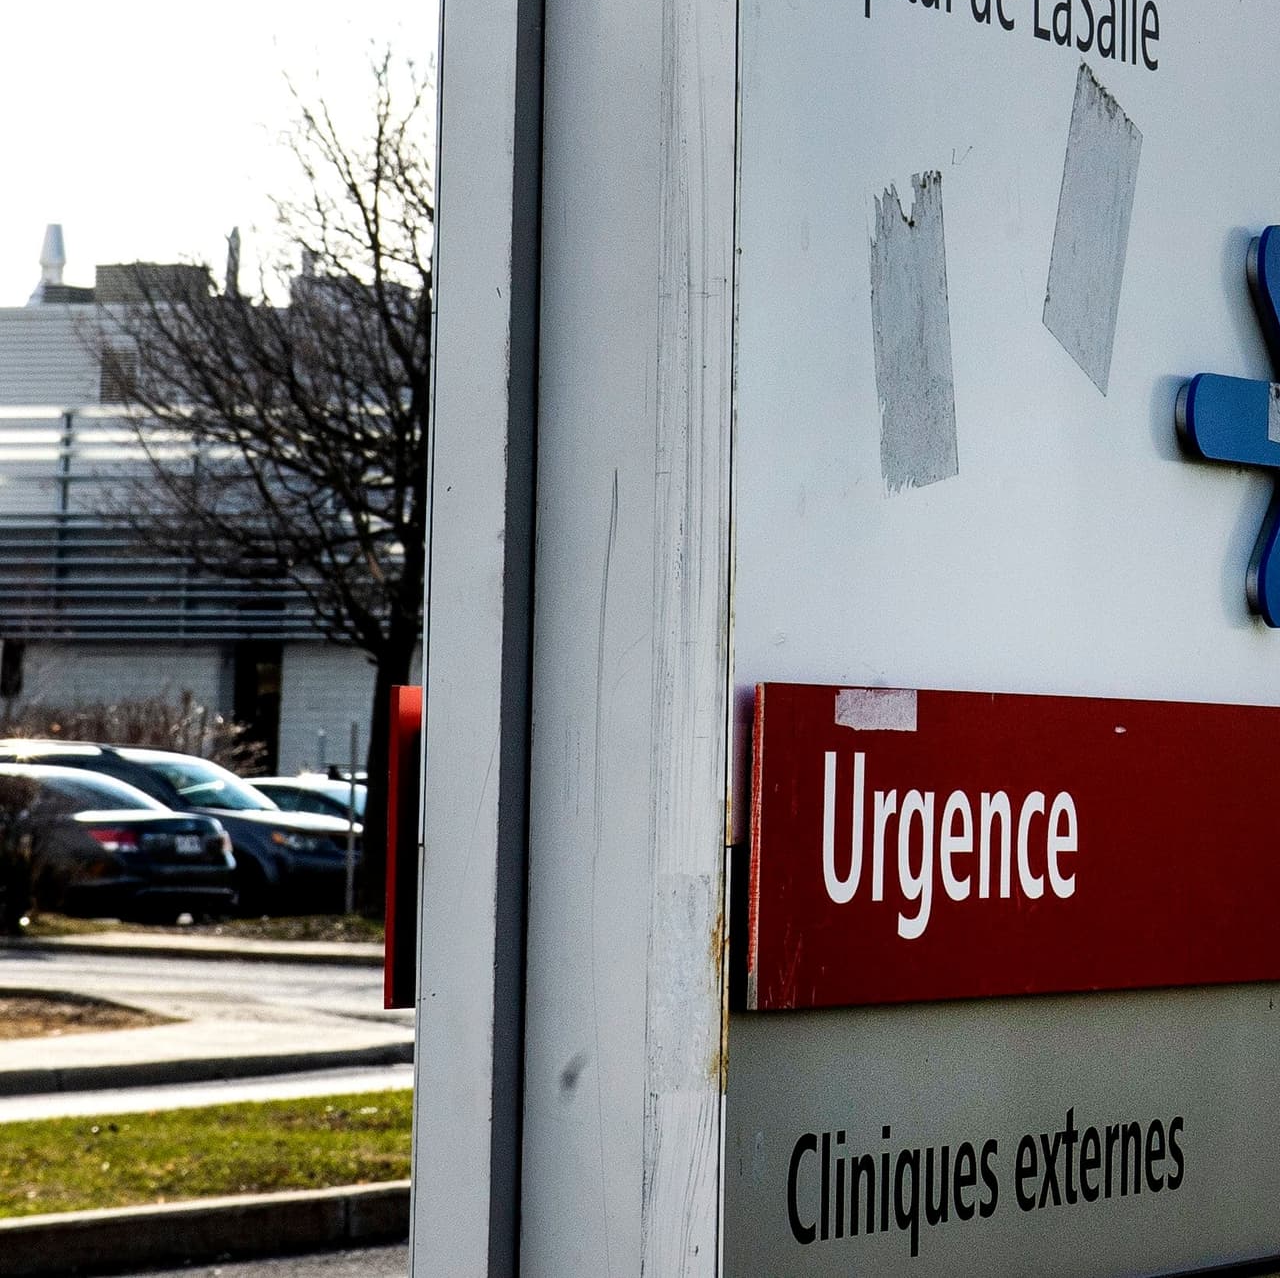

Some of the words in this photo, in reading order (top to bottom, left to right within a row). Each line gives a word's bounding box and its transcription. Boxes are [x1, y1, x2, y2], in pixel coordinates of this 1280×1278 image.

[823, 751, 1078, 939] Urgence
[787, 1126, 998, 1257] Cliniques
[1015, 1107, 1184, 1211] externes
